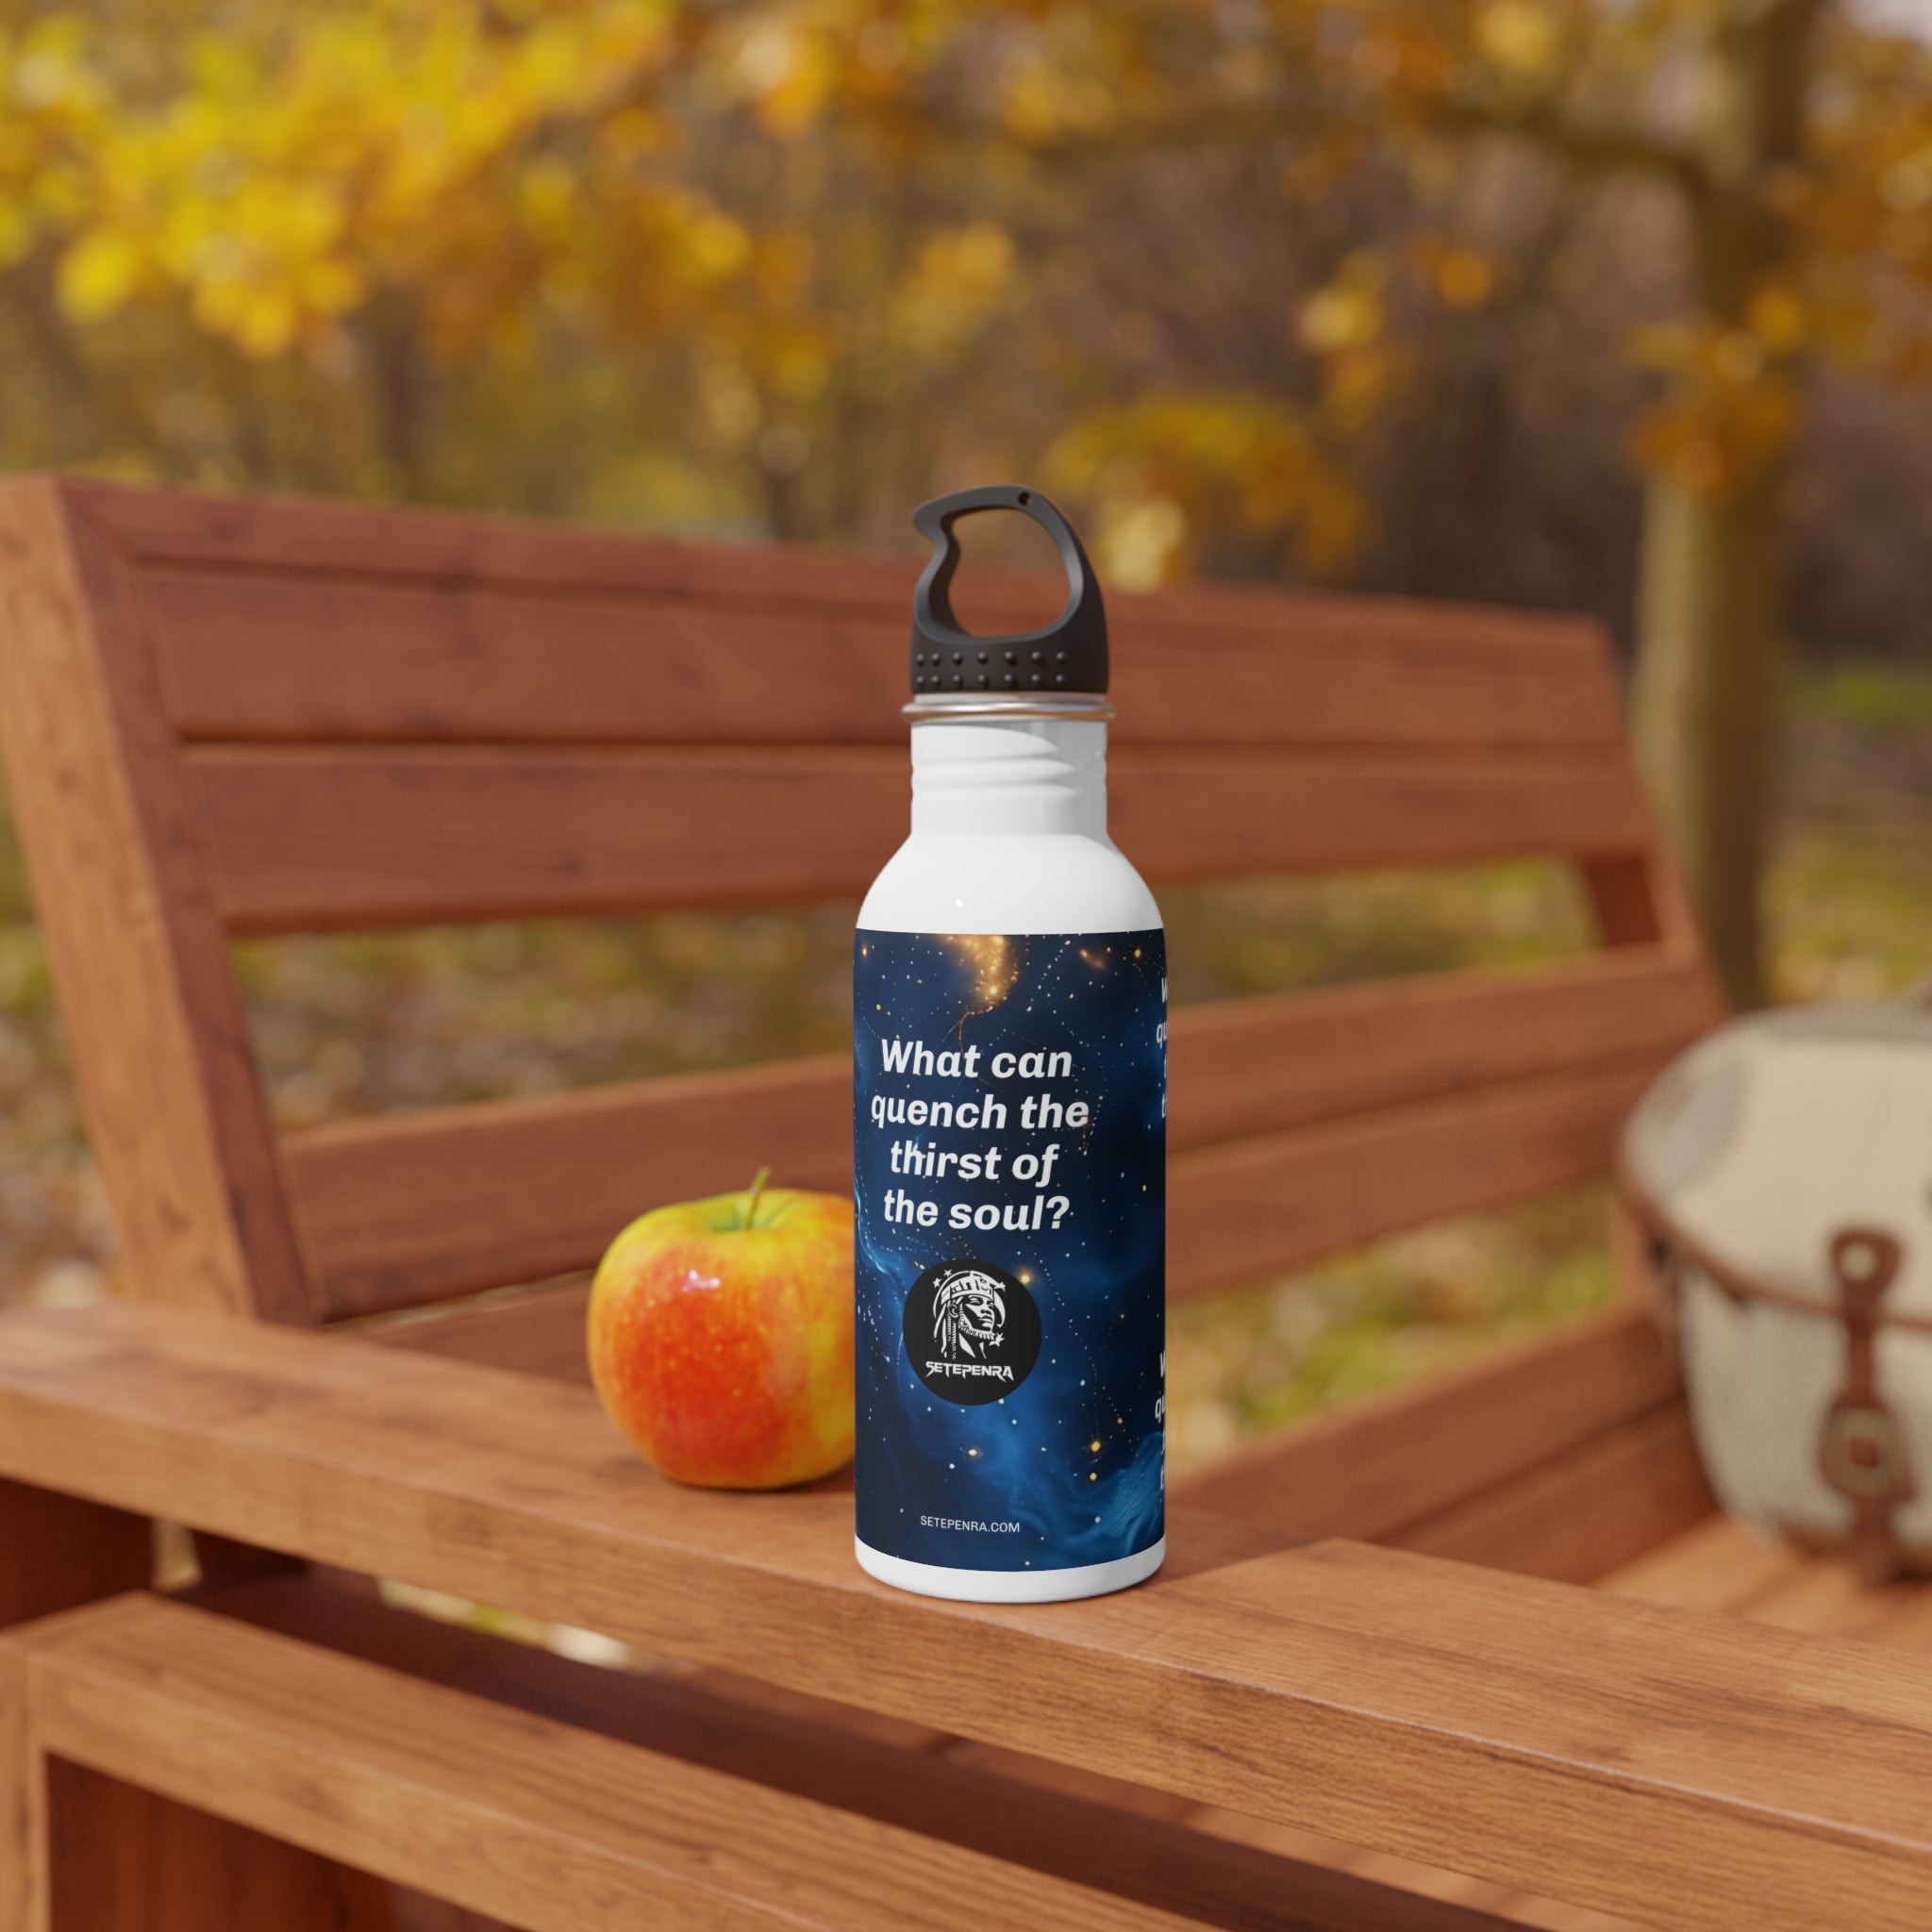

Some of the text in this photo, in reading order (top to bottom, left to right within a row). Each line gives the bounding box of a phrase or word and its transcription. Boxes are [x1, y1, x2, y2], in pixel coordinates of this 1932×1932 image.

[881, 1038, 1073, 1078] What can
[871, 1093, 1090, 1129] quench the
[890, 1140, 1060, 1188] thirst of
[883, 1189, 1070, 1231] the soul?
[925, 1360, 1015, 1383] SETEPENRA
[920, 1515, 1021, 1533] SETEPENRA.COM
